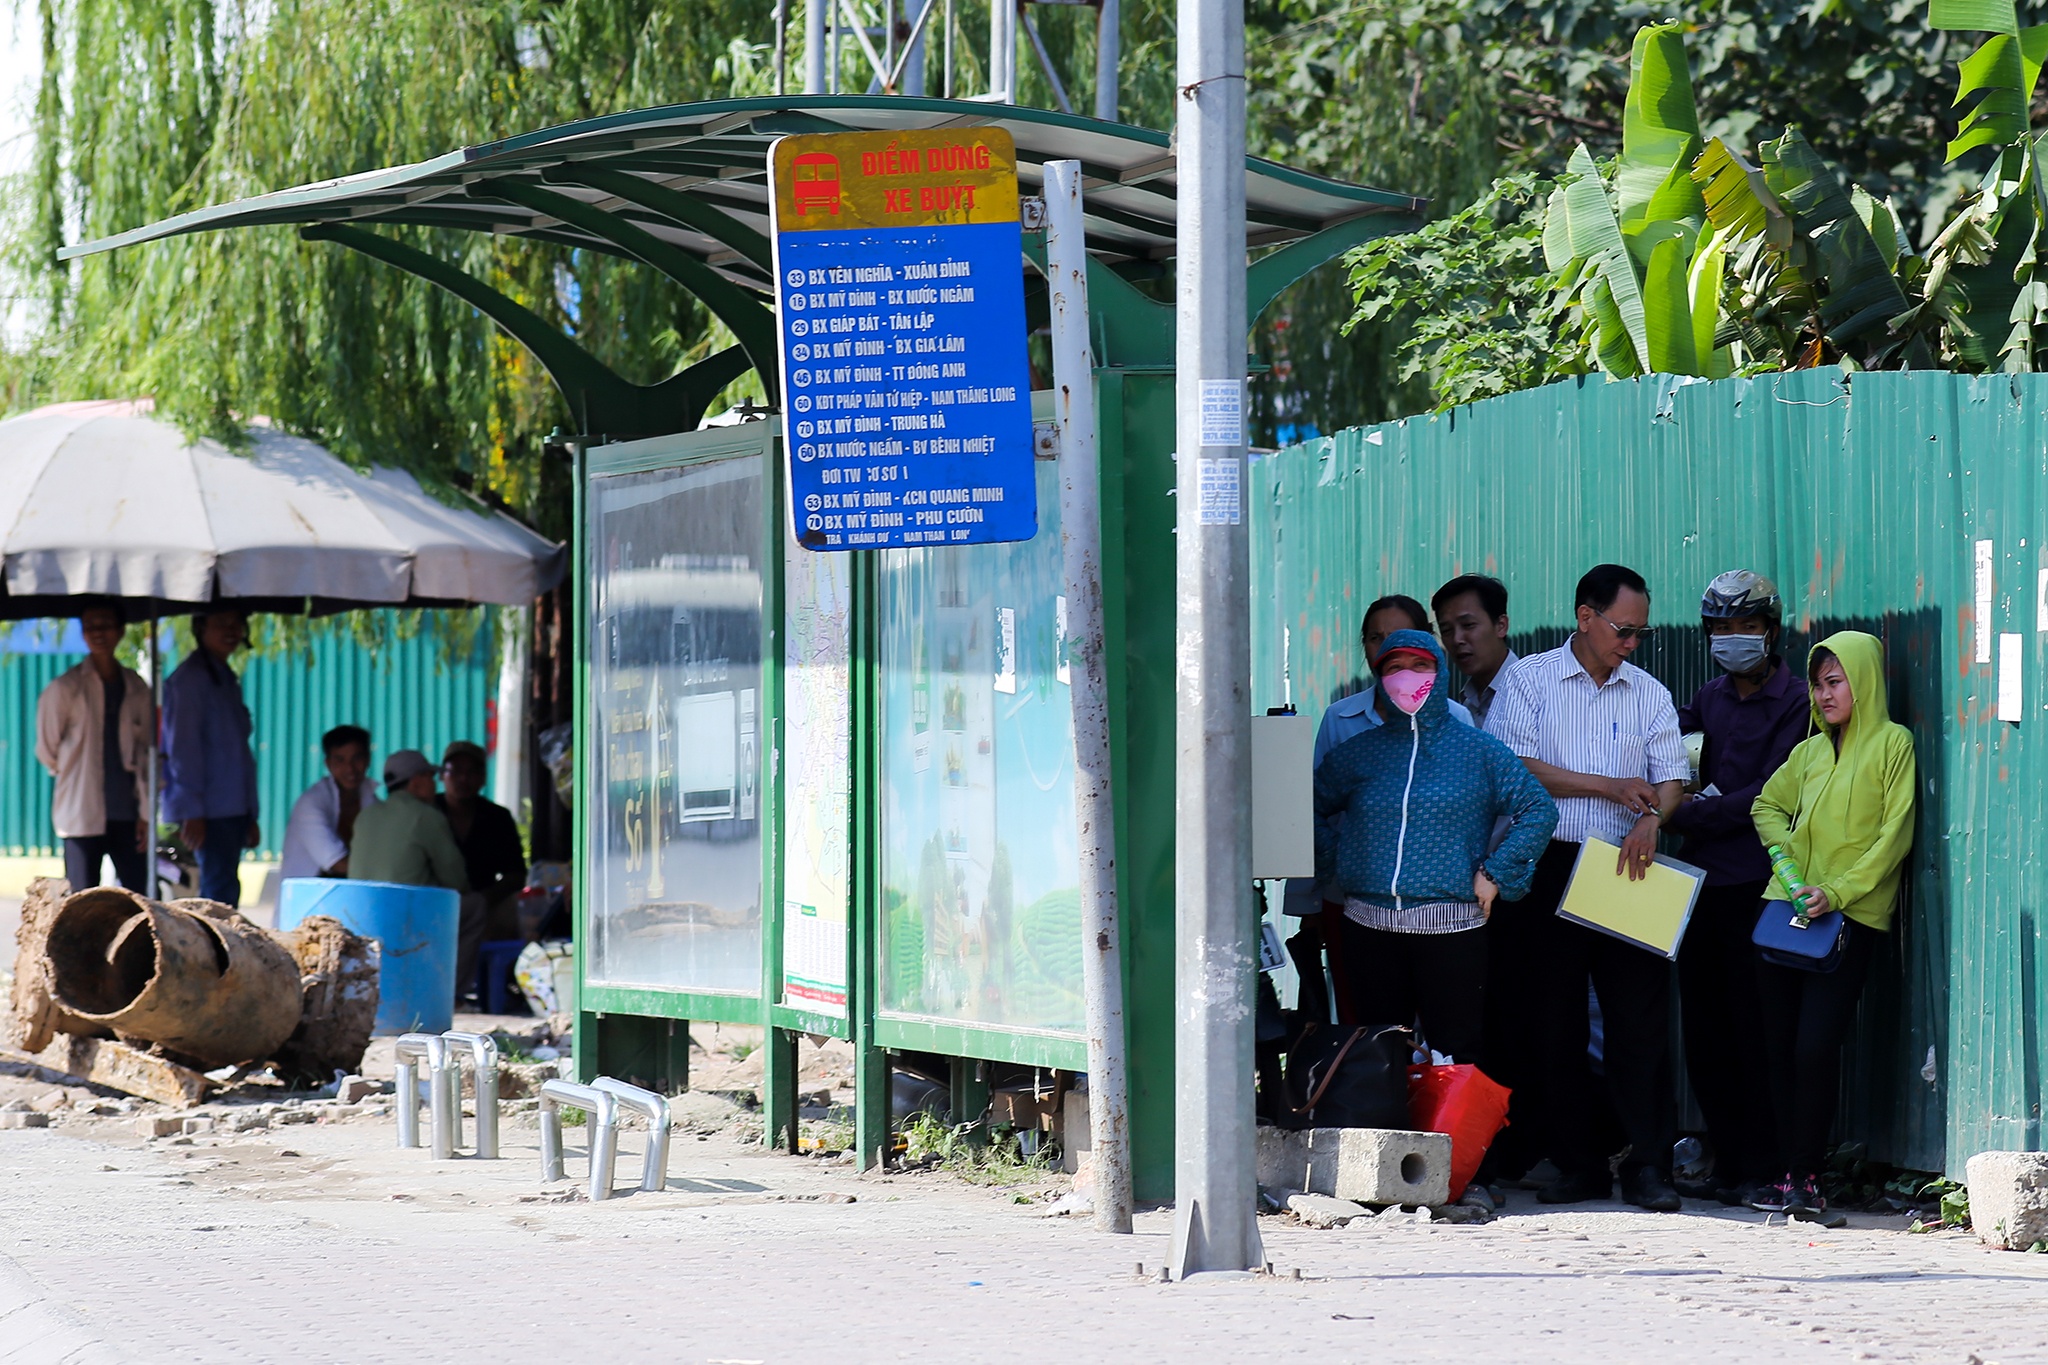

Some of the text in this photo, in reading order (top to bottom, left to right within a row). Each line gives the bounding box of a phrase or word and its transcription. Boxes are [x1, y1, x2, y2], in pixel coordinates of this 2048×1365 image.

[861, 140, 990, 177] ĐIỂM DỪNG
[883, 188, 913, 214] XE
[920, 179, 976, 212] BUÝT
[808, 269, 826, 285] BX
[828, 265, 853, 284] YÊN
[855, 263, 894, 283] NGHĨA
[904, 261, 938, 280] XUÂN
[939, 257, 970, 278] ĐỈNH
[809, 293, 826, 309] BX
[828, 290, 846, 308] MỸ
[888, 290, 904, 304] BX
[906, 284, 937, 304] NƯỚC
[812, 318, 828, 334] BX
[830, 314, 856, 333] GIÁP
[858, 313, 880, 331] BÁT
[889, 312, 911, 330] TÂN
[914, 311, 935, 332] LẬP
[813, 343, 831, 359] BX
[833, 339, 851, 358] MỸ
[896, 338, 913, 354] BX
[815, 369, 832, 385] BX
[834, 366, 851, 383] MỸ
[892, 366, 905, 381] TT
[942, 362, 966, 378] ANH
[836, 390, 862, 409] PHÁP
[864, 389, 884, 408] VÂN
[901, 389, 923, 409] HIỆP
[931, 390, 955, 405] NAM
[990, 386, 1016, 402] LONG
[817, 420, 832, 435] BX
[835, 416, 852, 433] MỸ
[891, 414, 928, 430] TRUNG
[818, 443, 834, 459] BX
[836, 438, 867, 457] NƯỚC
[913, 439, 928, 455] BV
[963, 434, 995, 456] NHIỆT
[843, 467, 861, 483] TW
[823, 494, 840, 509] BX
[842, 490, 860, 508] MỸ
[929, 488, 969, 506] QUANG
[972, 487, 1003, 502] MINH
[825, 514, 843, 529] BX
[846, 511, 867, 529] MỸ
[903, 532, 923, 542] NAM
